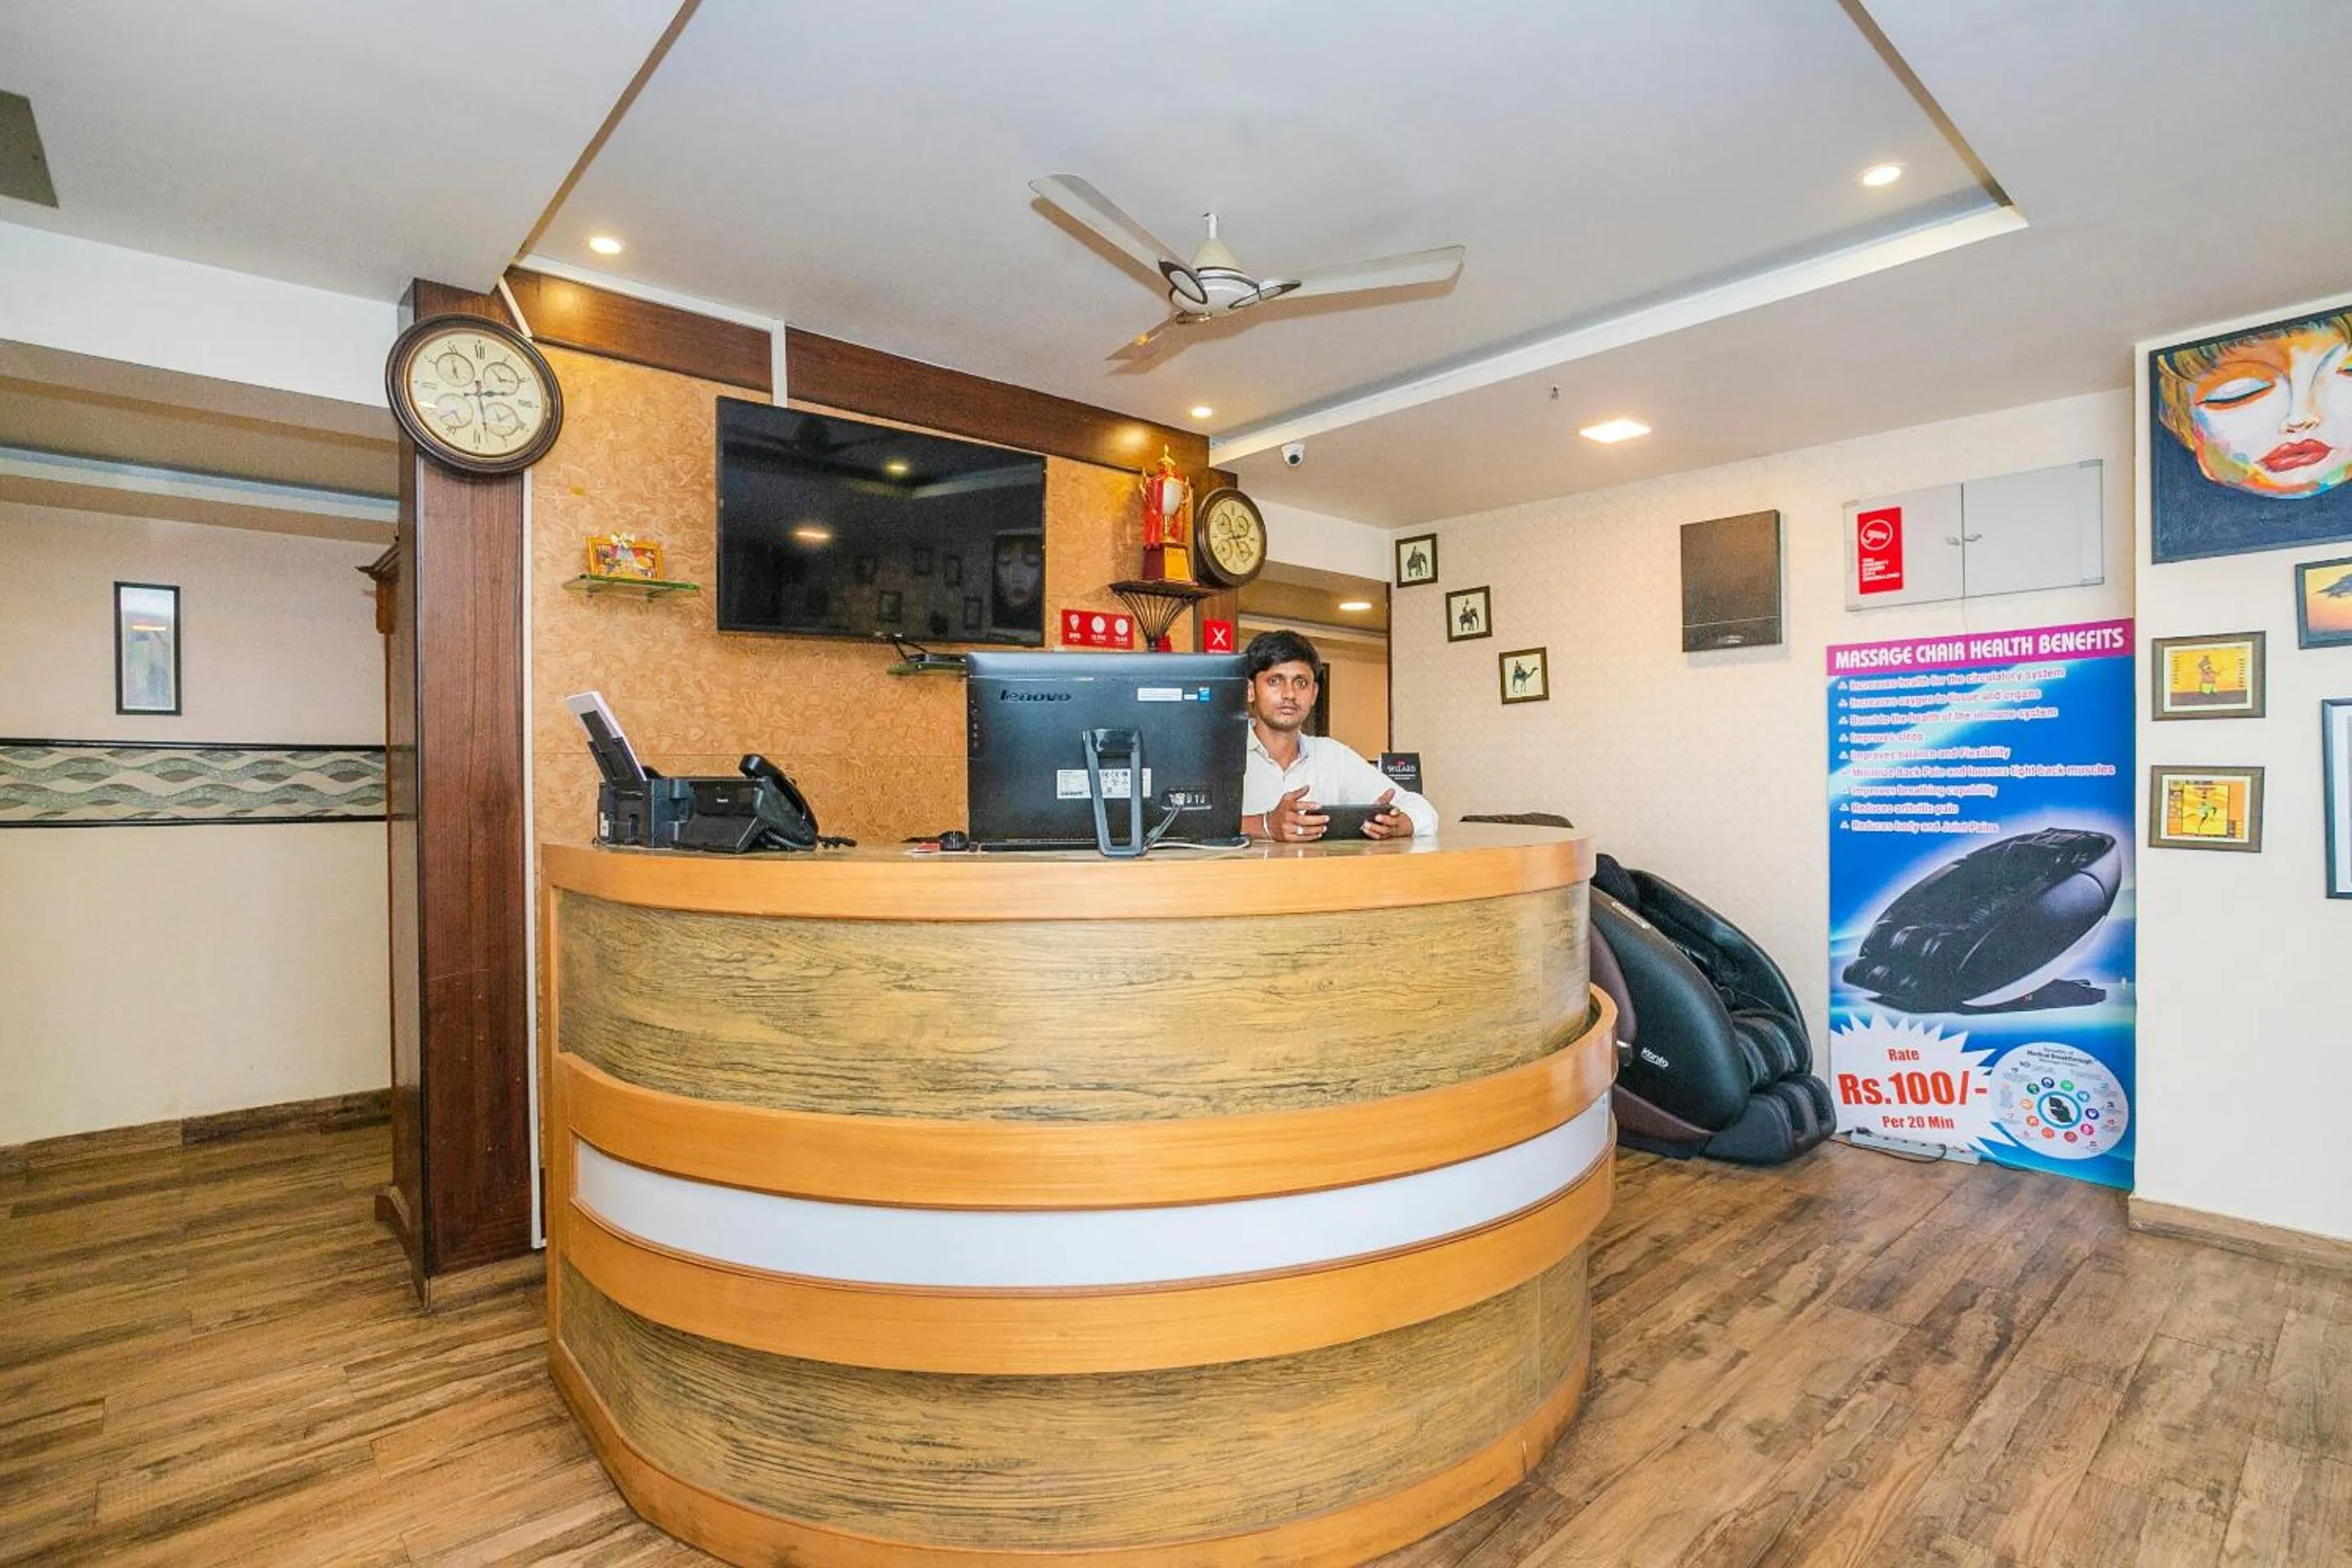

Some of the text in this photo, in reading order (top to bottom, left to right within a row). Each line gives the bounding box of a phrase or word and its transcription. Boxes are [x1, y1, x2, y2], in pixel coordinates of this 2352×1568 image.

[1835, 627, 2123, 670] MASSAGE CHAIR HEALTH BENEFITS
[1948, 675, 1964, 684] the
[1967, 671, 2022, 683] circulatory
[2025, 669, 2065, 681] system
[1000, 689, 1071, 702] lenovo
[1899, 696, 1933, 707] oxygen
[1982, 691, 2000, 701] and
[2004, 689, 2040, 702] organs
[1891, 714, 1907, 724] the
[1943, 712, 1951, 722] of
[1955, 711, 1970, 720] the
[1973, 710, 2016, 719] immune
[2019, 707, 2057, 720] system
[1851, 733, 1922, 744] Improves sleep
[1851, 751, 1895, 760] Improves
[1898, 749, 1936, 759] balance
[1938, 749, 1958, 759] and
[1896, 767, 1920, 777] Back
[1922, 767, 1944, 777] Pain
[1948, 766, 1966, 776] and
[2011, 764, 2035, 777] tight
[2037, 764, 2065, 775] back
[2067, 764, 2114, 775] muscles
[1851, 786, 1895, 797] Improves
[1897, 785, 1944, 797] breathing
[1851, 803, 1958, 815] Reduces arthritis pain
[1851, 820, 1893, 831] Reduces
[1895, 821, 1918, 833] body
[1921, 822, 1940, 831] and
[1969, 822, 1998, 832] Pains
[1888, 1049, 1919, 1061] Rate
[1838, 1070, 1988, 1105] Rs.100/-
[1882, 1116, 1954, 1129] Per 20 Min
